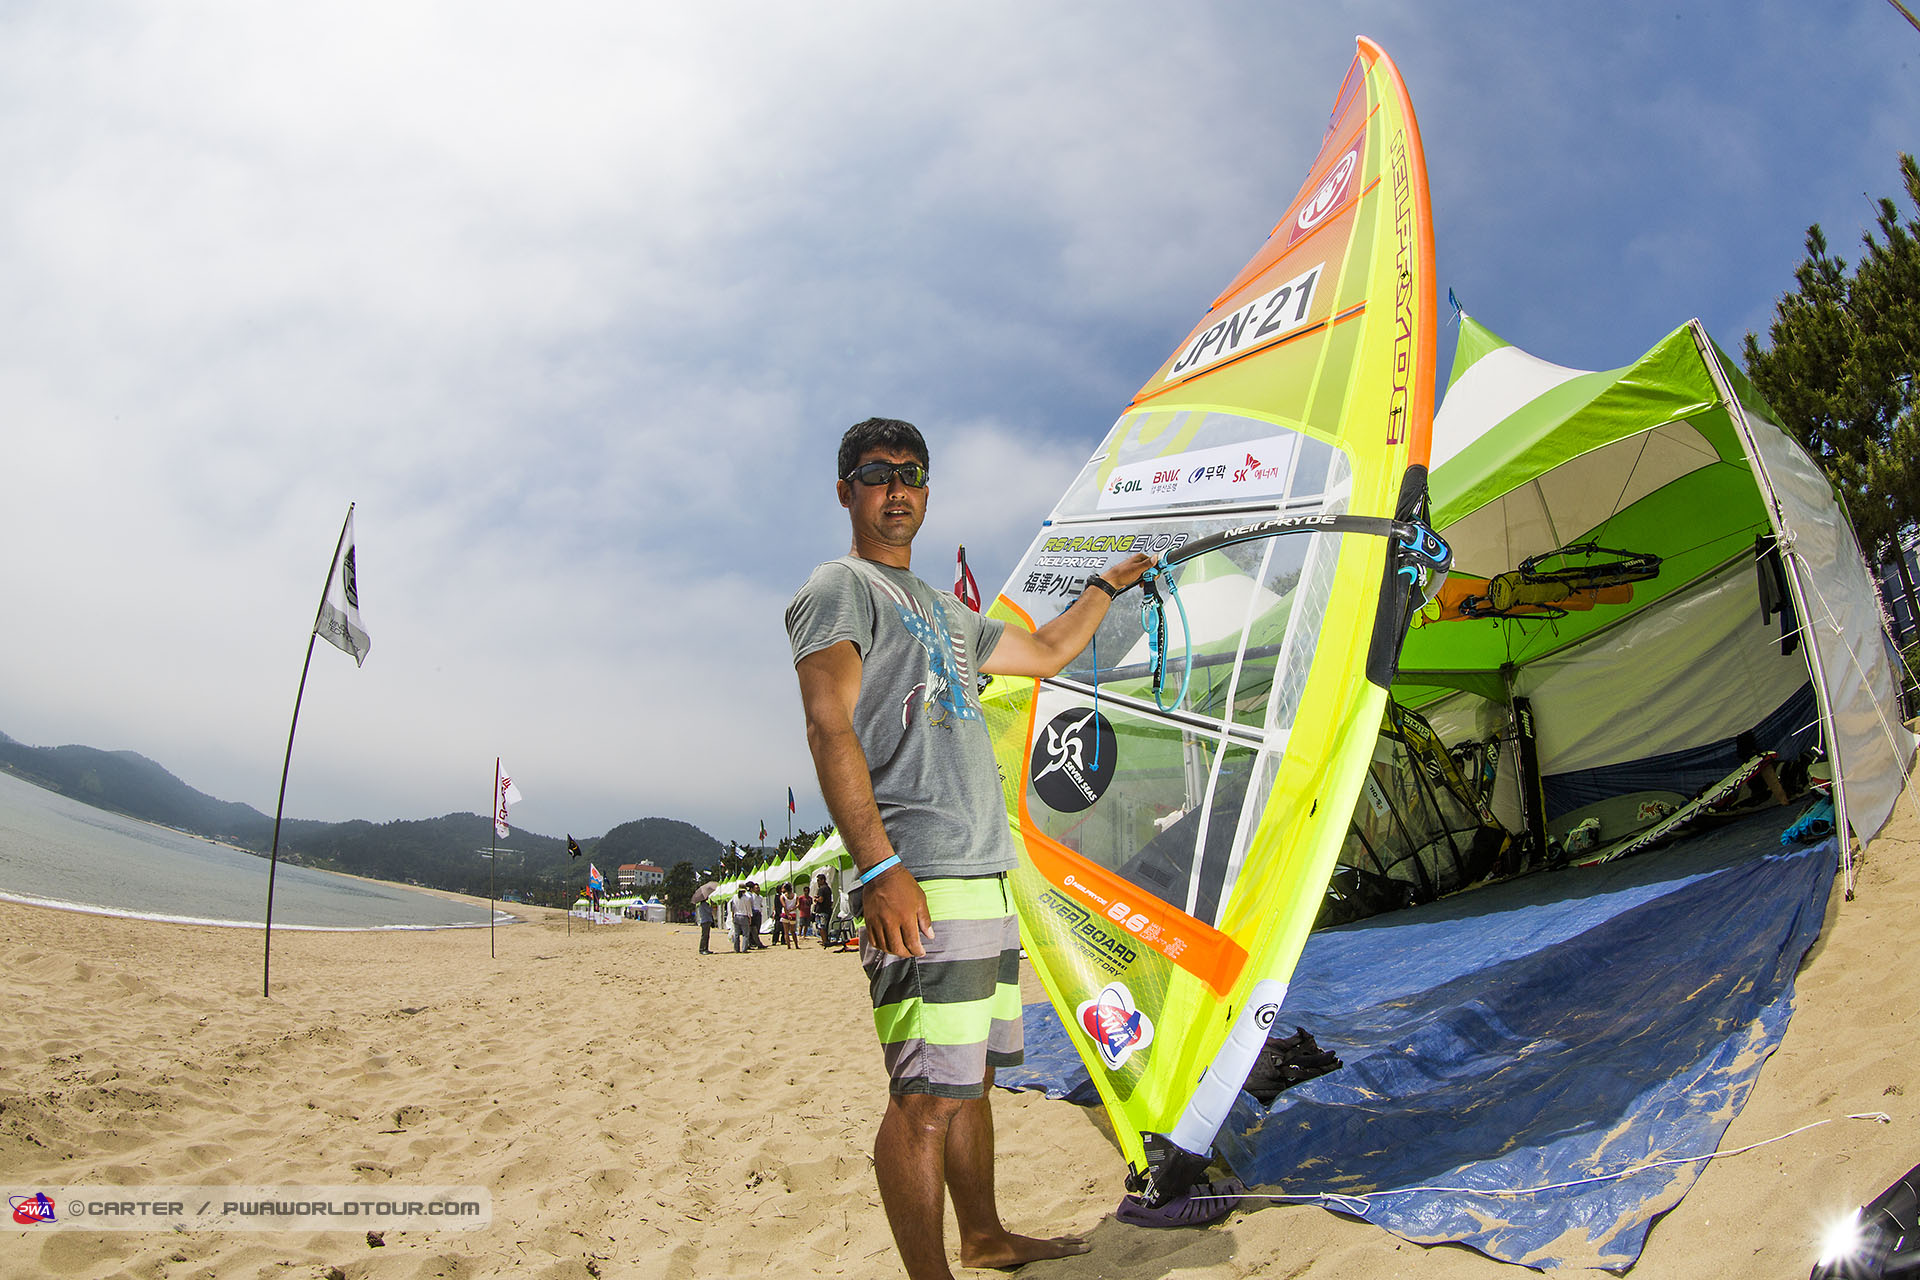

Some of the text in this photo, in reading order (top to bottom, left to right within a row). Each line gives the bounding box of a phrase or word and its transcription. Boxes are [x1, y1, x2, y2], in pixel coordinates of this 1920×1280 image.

[1386, 129, 1413, 445] NEILPRYDE
[1173, 269, 1319, 373] JPN-21
[1205, 464, 1227, 481] 무학
[1232, 467, 1279, 483] SK 에너지
[1035, 556, 1108, 569] NEILPRYDE
[1065, 761, 1098, 801] SEVEN SEAS
[1071, 881, 1109, 907] NEILPRYDE
[1107, 902, 1150, 933] 8.6
[1126, 1026, 1138, 1040] TOUR
